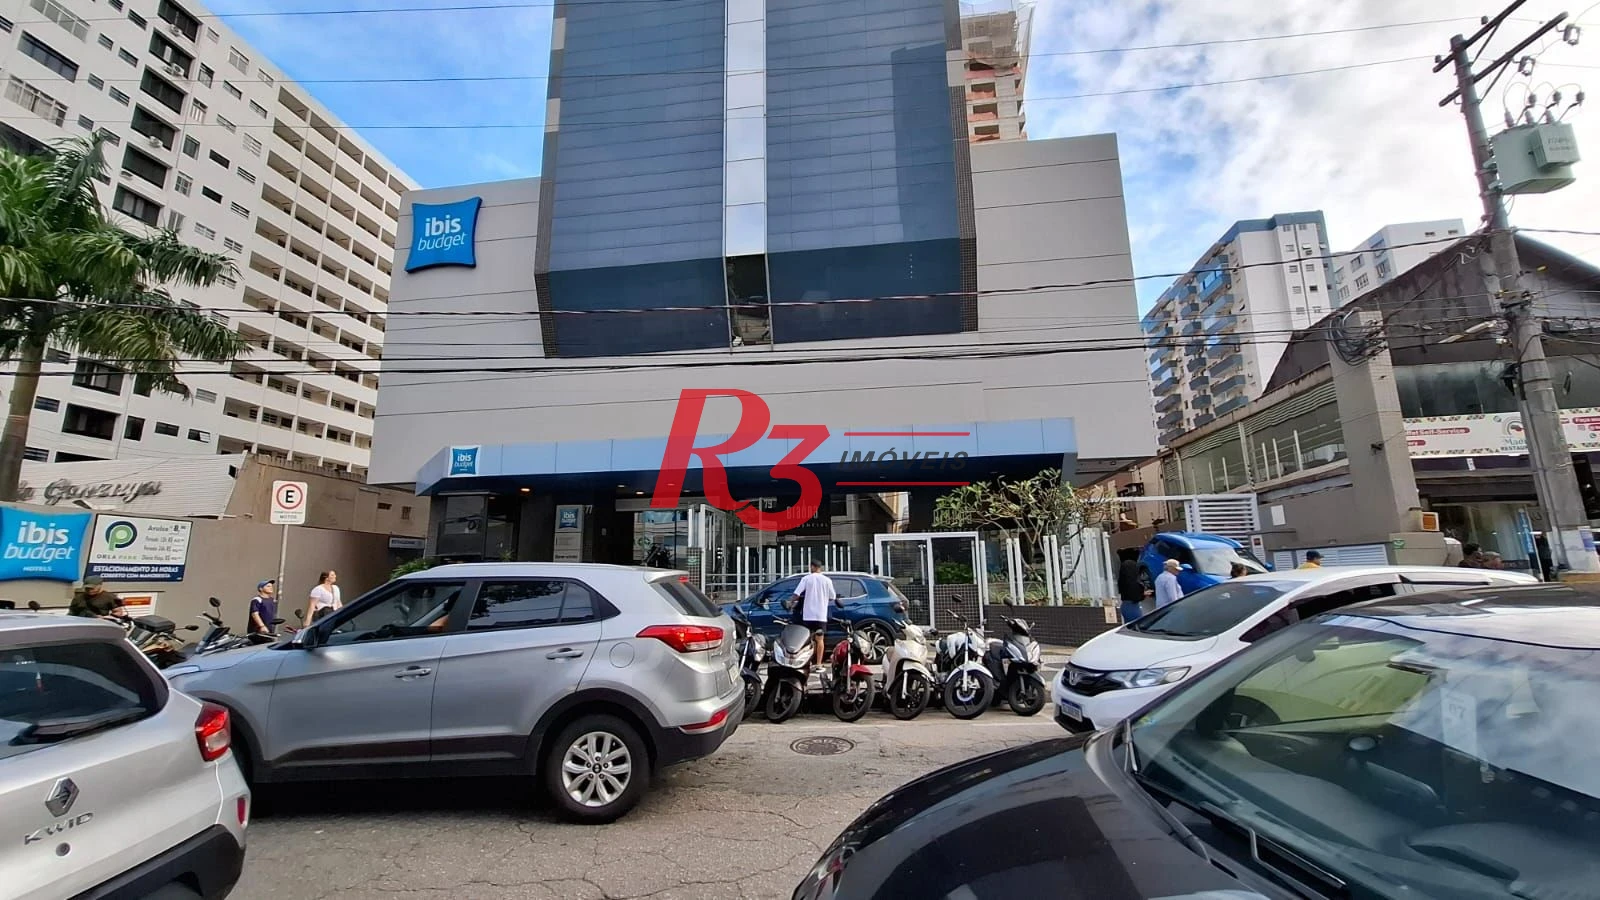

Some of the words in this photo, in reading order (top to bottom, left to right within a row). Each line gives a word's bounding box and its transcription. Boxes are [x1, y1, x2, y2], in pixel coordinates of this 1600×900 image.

[424, 214, 461, 237] ibis
[417, 232, 467, 251] budget
[457, 453, 472, 462] ibis
[285, 490, 295, 503] E
[16, 520, 69, 546] ibis
[3, 542, 76, 564] budget
[92, 565, 150, 573] ESTACIONAMENTO
[24, 813, 95, 845] KWID
